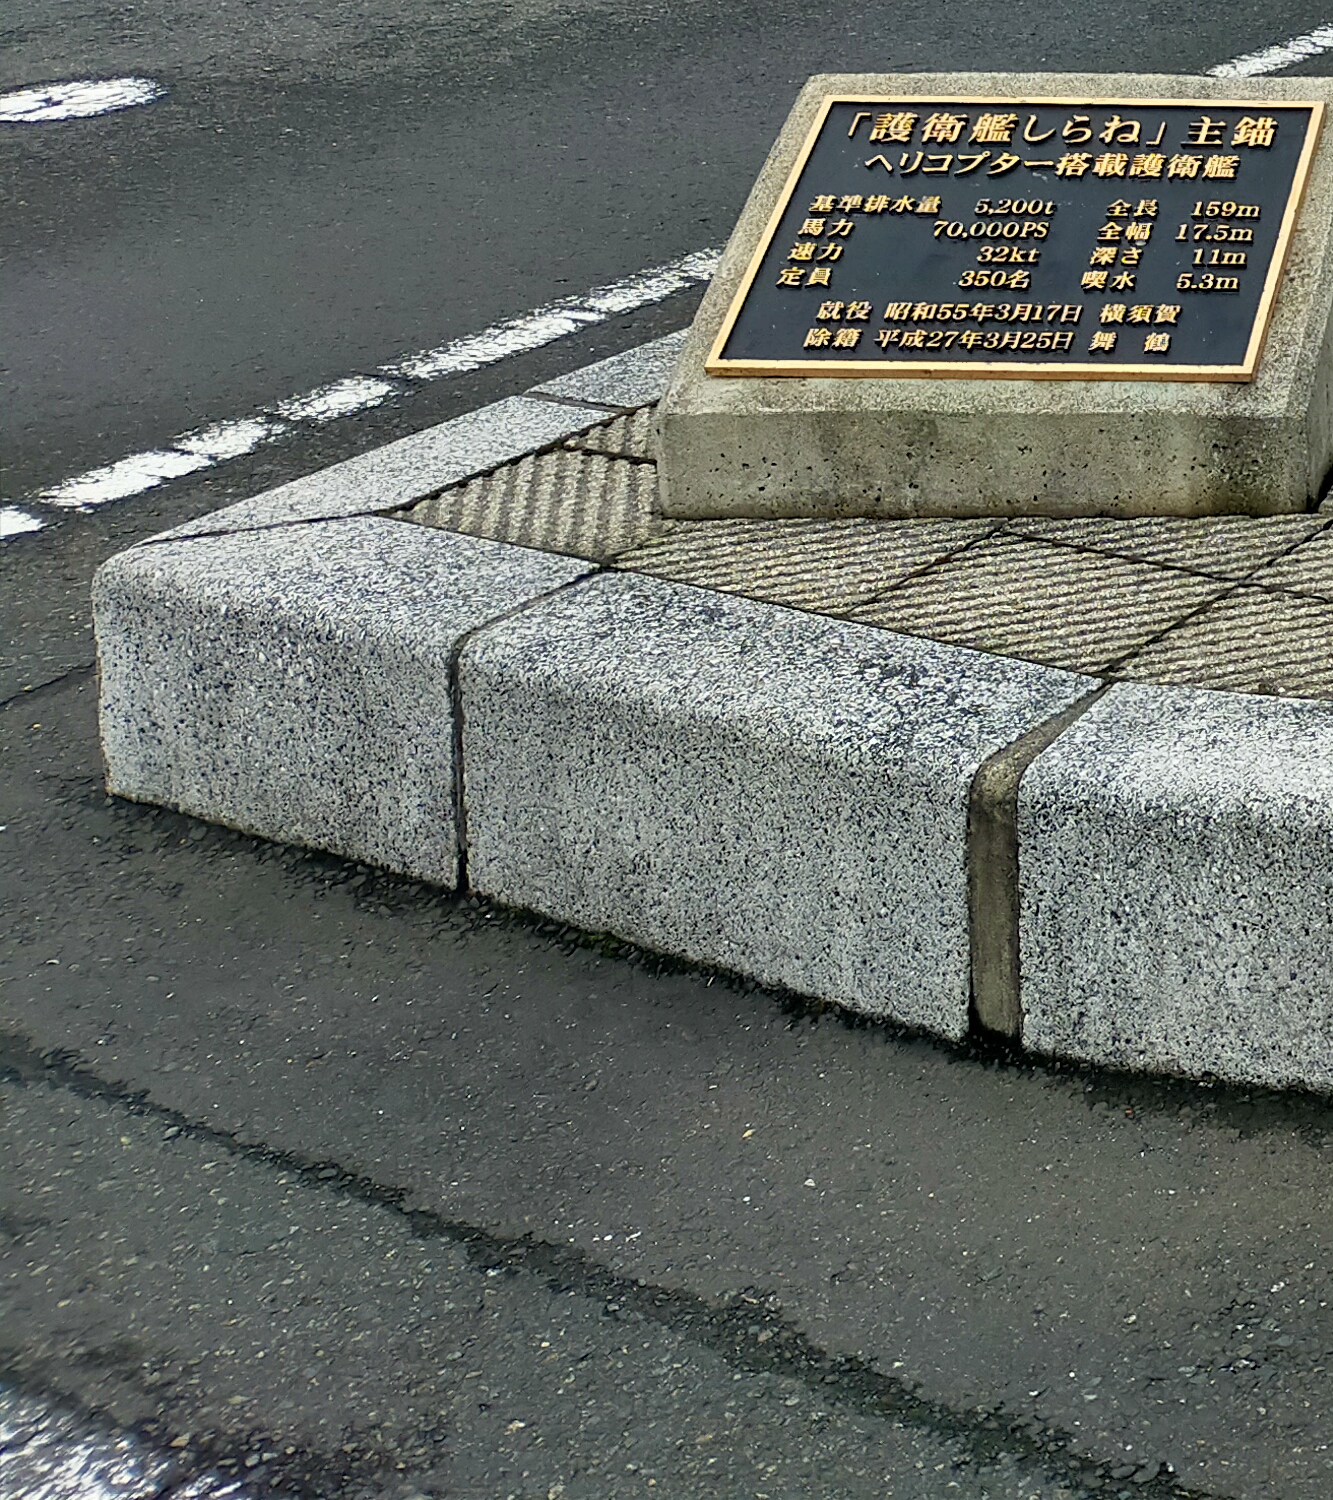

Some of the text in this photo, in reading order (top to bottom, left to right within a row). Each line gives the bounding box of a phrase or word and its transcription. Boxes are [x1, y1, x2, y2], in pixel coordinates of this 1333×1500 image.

[864, 152, 1241, 179] ヘリコプター搭載護衛艦
[809, 195, 1056, 215] 基準排水量 5,200t
[1106, 199, 1261, 218] 全長 159m
[797, 218, 1050, 239] 馬力 70,000PS
[1097, 222, 1254, 242] 全幅 17.5m
[787, 242, 1040, 263] 速力 32kt
[1090, 247, 1247, 266] 深さ 11m
[776, 267, 1031, 289] 定員 350名
[1081, 271, 1240, 291] 喫水 5.3m
[816, 301, 1181, 324] 就役 昭和55年3月17日 横須賀
[803, 328, 862, 348] 除籍
[874, 329, 1074, 350] 平成27年3月25日
